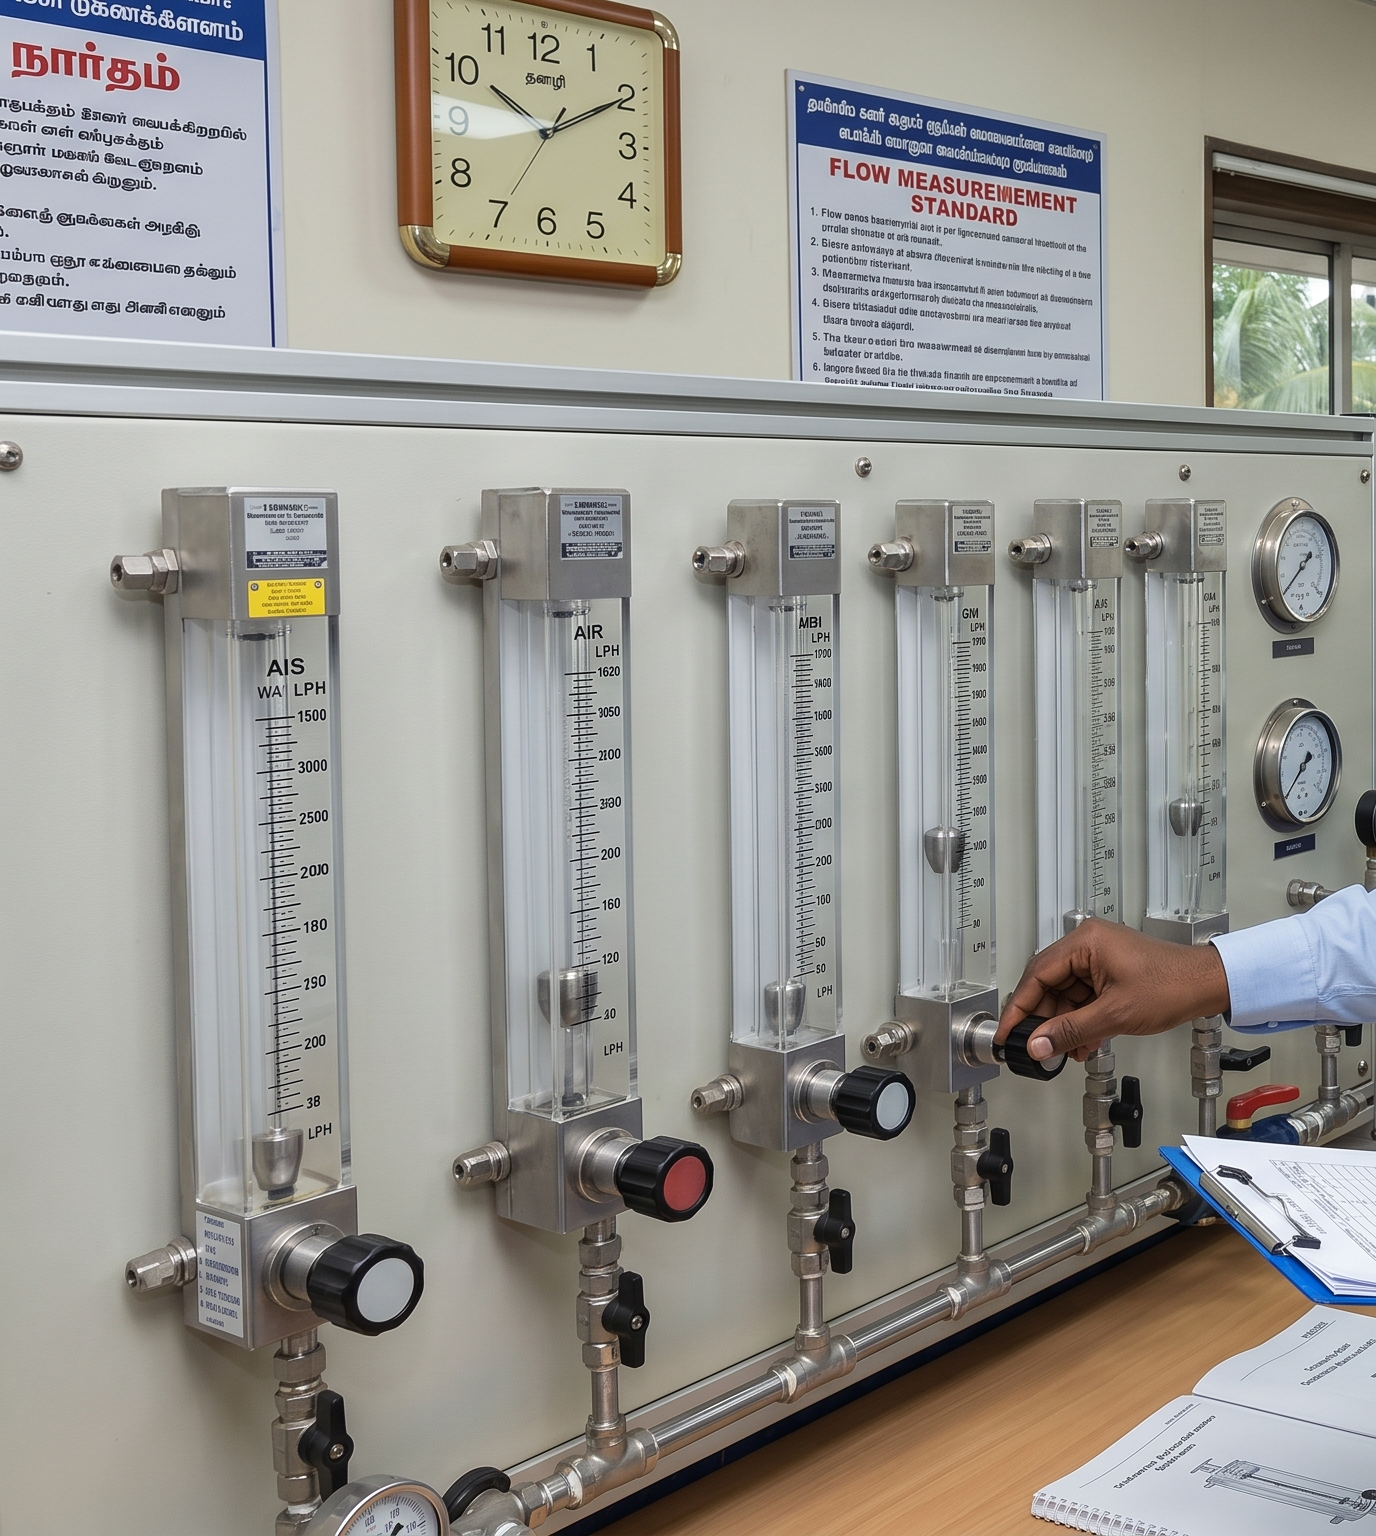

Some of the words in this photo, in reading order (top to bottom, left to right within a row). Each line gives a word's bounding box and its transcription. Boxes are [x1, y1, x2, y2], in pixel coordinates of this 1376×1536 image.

[481, 23, 505, 55] 11
[527, 32, 560, 64] 12
[586, 43, 596, 72] 1
[445, 52, 479, 85] 10
[617, 84, 636, 112] 2
[448, 105, 469, 135] 9
[618, 132, 637, 160] 3
[450, 158, 472, 187] 8
[829, 157, 890, 185] FLOW
[617, 182, 637, 209] 4
[488, 199, 509, 228] 7
[910, 194, 1018, 227] STANDARD
[537, 207, 557, 235] 6
[586, 211, 605, 239] 5
[810, 207, 818, 216] 1.
[821, 208, 842, 219] Flow
[943, 226, 956, 236] per
[810, 237, 819, 246] 2.
[811, 267, 819, 277] 3.
[811, 298, 820, 307] 4.
[812, 332, 821, 341] 5.
[823, 332, 841, 343] Tha
[812, 362, 821, 371] 6.
[573, 624, 604, 640] AIR
[811, 632, 830, 643] LPH
[595, 644, 620, 658] LPH
[266, 658, 306, 677] AIS
[597, 665, 621, 678] 1620
[294, 681, 326, 697] LPH
[297, 708, 327, 723] 1500
[298, 758, 328, 773] 3000
[299, 809, 329, 826] 2500
[601, 846, 621, 861] 200
[815, 854, 832, 867] 200
[602, 896, 621, 911] 160
[816, 893, 831, 906] 100
[303, 918, 328, 934] 180
[602, 951, 620, 965] 120
[817, 984, 833, 999] LPH
[303, 1034, 327, 1051] 200
[604, 1041, 624, 1057] LPH
[306, 1094, 321, 1110] 38
[308, 1122, 333, 1141] LPH
